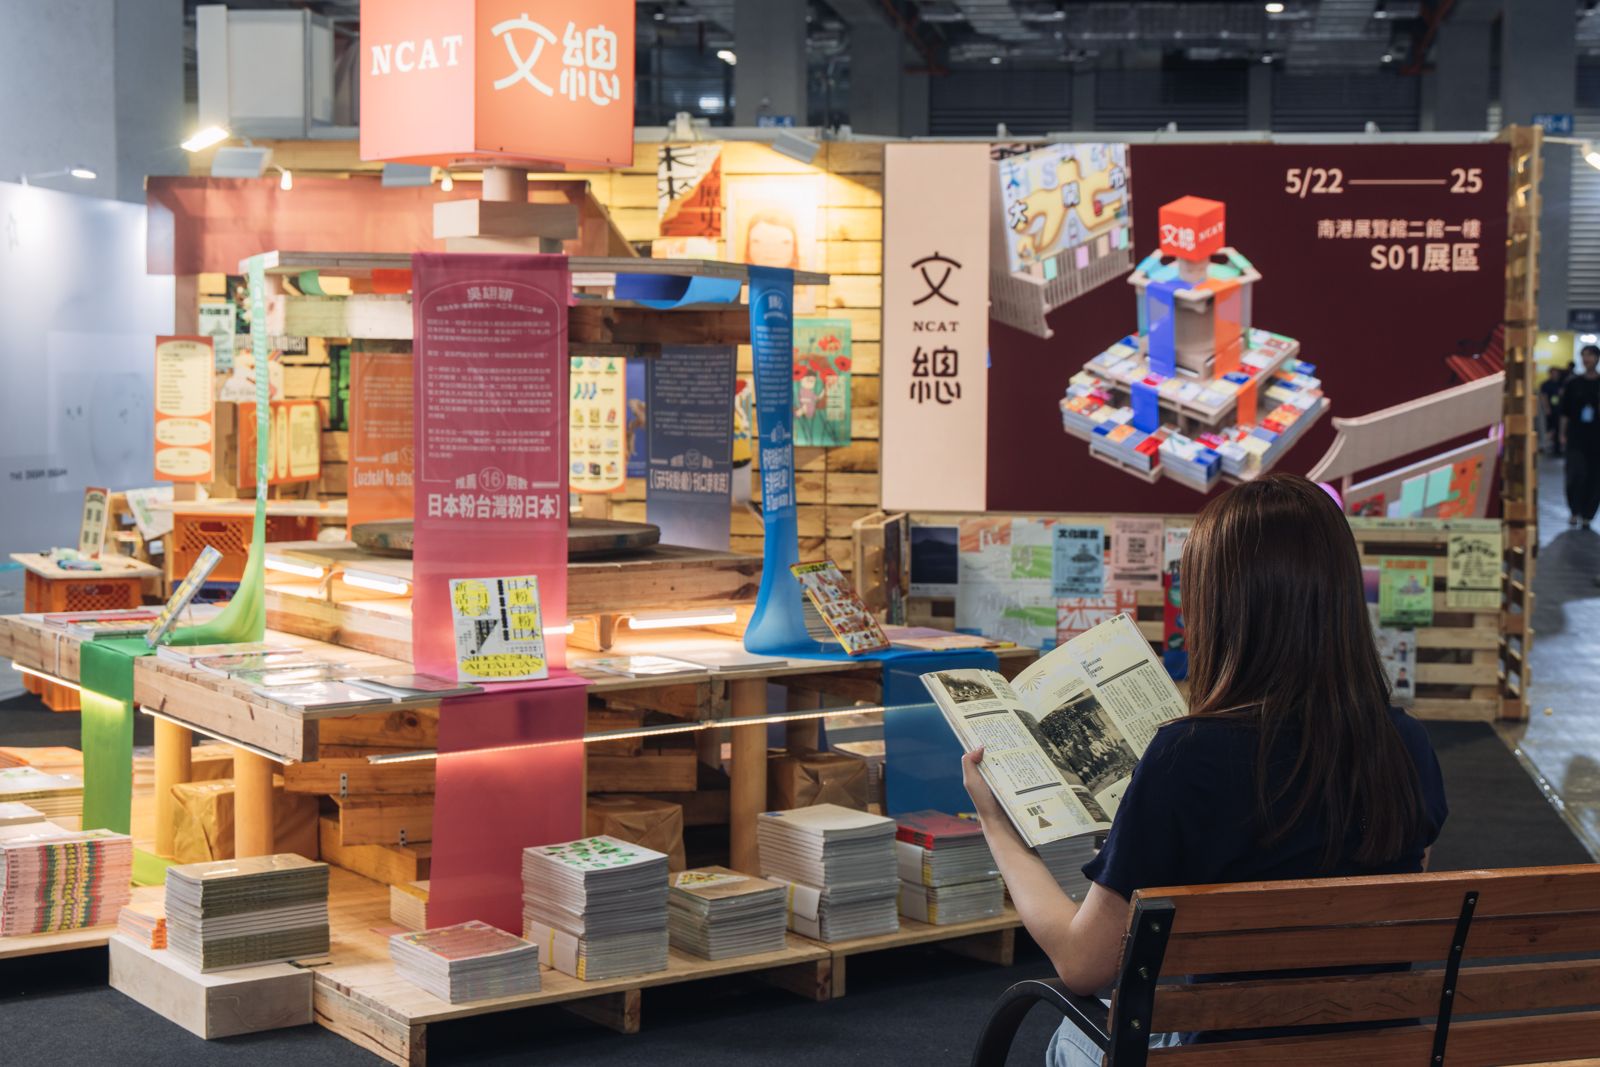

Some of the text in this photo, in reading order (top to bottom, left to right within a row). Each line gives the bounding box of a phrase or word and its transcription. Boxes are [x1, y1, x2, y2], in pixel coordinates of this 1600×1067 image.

[370, 35, 463, 76] NCAT
[491, 13, 620, 106] 文總
[1285, 167, 1483, 199] 5/22 25
[1317, 218, 1481, 239] 南港展覽館二館一樓
[1370, 243, 1480, 272] S01展區
[911, 251, 962, 306] 文
[912, 321, 960, 332] NCAT
[909, 345, 962, 405] 總
[483, 471, 501, 487] 16
